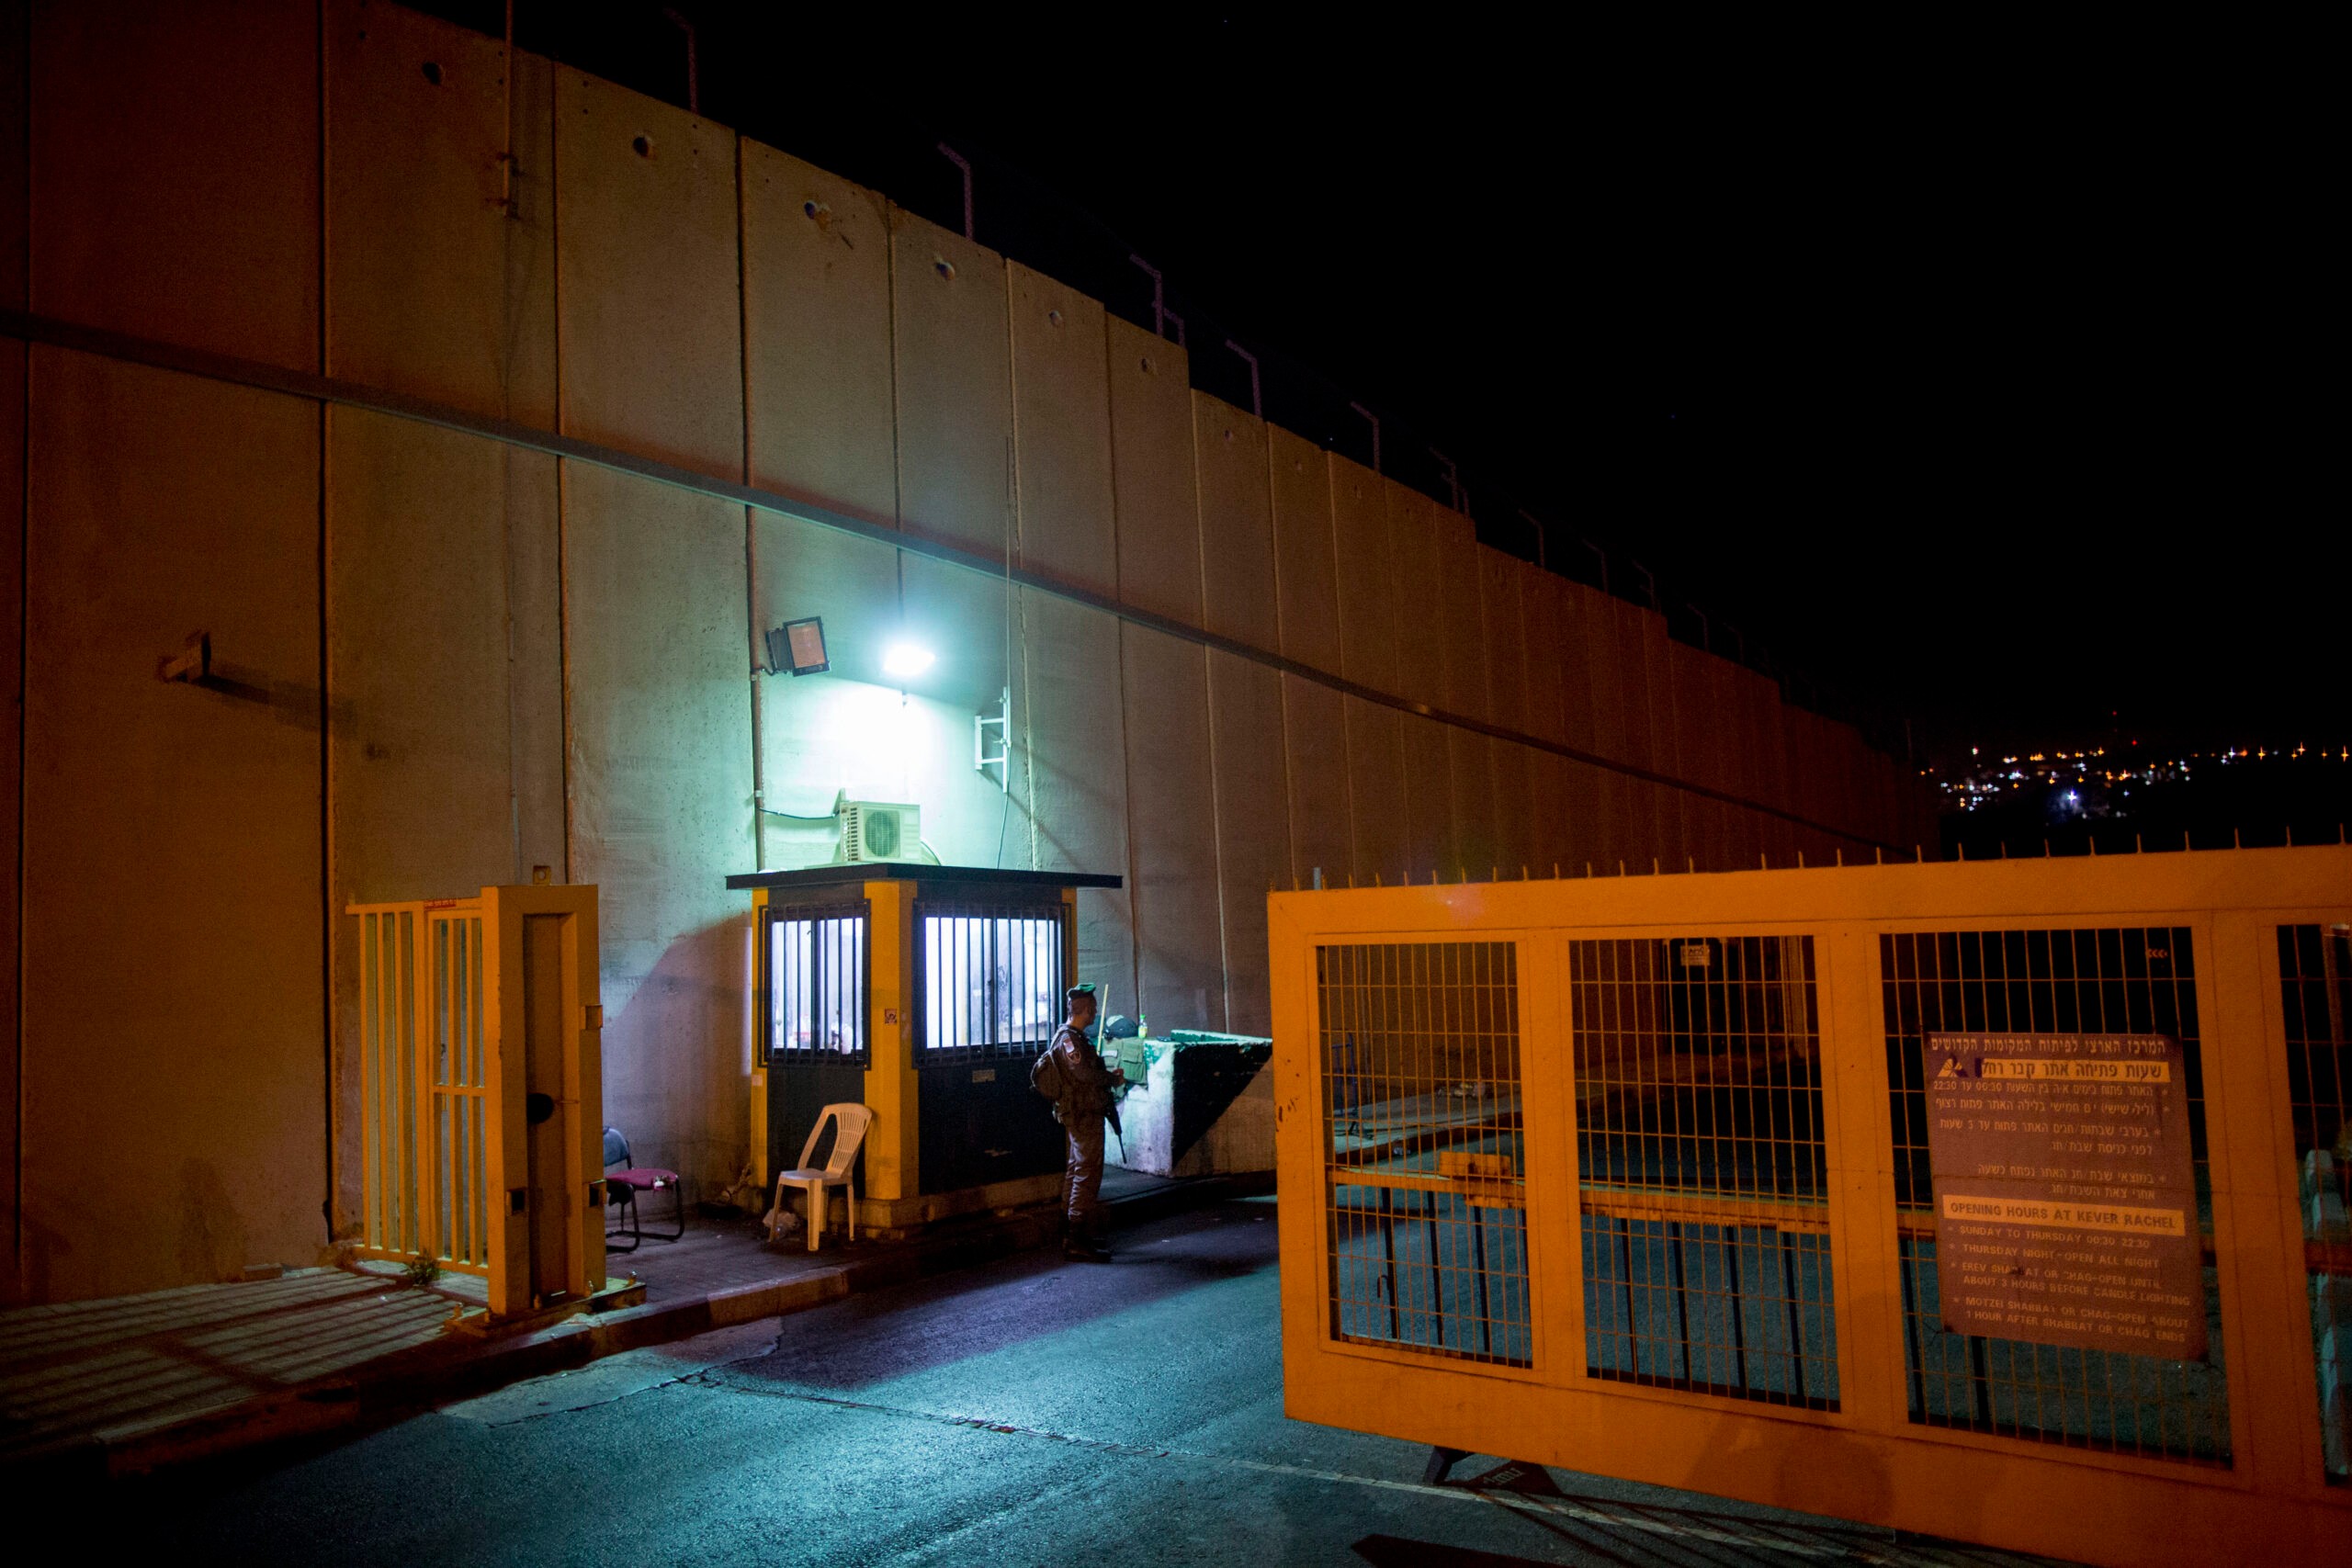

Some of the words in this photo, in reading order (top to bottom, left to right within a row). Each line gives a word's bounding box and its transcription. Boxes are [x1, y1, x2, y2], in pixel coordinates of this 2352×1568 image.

[1931, 1038, 1977, 1055] הקדושים
[1984, 1038, 2031, 1055] המקומות
[2039, 1036, 2078, 1053] לפיתוח
[2085, 1039, 2120, 1054] הארצי
[2127, 1039, 2165, 1055] המרכז
[2009, 1062, 2035, 1079] קבר
[2041, 1063, 2069, 1077] אתר
[2075, 1063, 2118, 1077] פתיחה
[2125, 1064, 2162, 1082] שעות
[2127, 1086, 2154, 1096] האתר
[1986, 1100, 2014, 1111] האתר
[2018, 1100, 2046, 1111] בלילה
[2084, 1103, 2097, 1113] ים
[1951, 1201, 2002, 1216] OPENING
[2007, 1206, 2048, 1220] HOURS
[2053, 1209, 2072, 1222] AT
[2076, 1210, 2119, 1225] KEVER
[2124, 1213, 2177, 1229] RACHEL
[1960, 1225, 2002, 1237] SUNDAY
[2007, 1227, 2021, 1238] TO
[2025, 1230, 2082, 1244] THURSDAY
[1962, 1244, 2018, 1257] THURSDAY
[2098, 1254, 2120, 1266] ALL
[2124, 1257, 2159, 1269] NIGHT
[1962, 1261, 1986, 1273] EREV
[1991, 1264, 2040, 1278] SHAAT
[2043, 1269, 2059, 1280] OR
[1962, 1275, 1997, 1287] ABOUT
[2001, 1278, 2007, 1288] 3
[2011, 1279, 2046, 1292] HOURS
[2049, 1282, 2089, 1296] BEFORE
[2093, 1287, 2137, 1301] CANDLE
[2139, 1292, 2191, 1307] LIGHTING
[1965, 1296, 2005, 1309] MOTZEI
[2060, 1305, 2075, 1316] OR
[2152, 1315, 2188, 1329] ABOUT
[1966, 1310, 1972, 1320] 1
[1974, 1311, 2003, 1322] HOUR
[2007, 1314, 2039, 1326] AFTER
[2042, 1317, 2093, 1332] SHABBAT
[2098, 1324, 2113, 1335] OR
[2117, 1325, 2150, 1339] CHAG
[2154, 1330, 2186, 1344] ENDS
